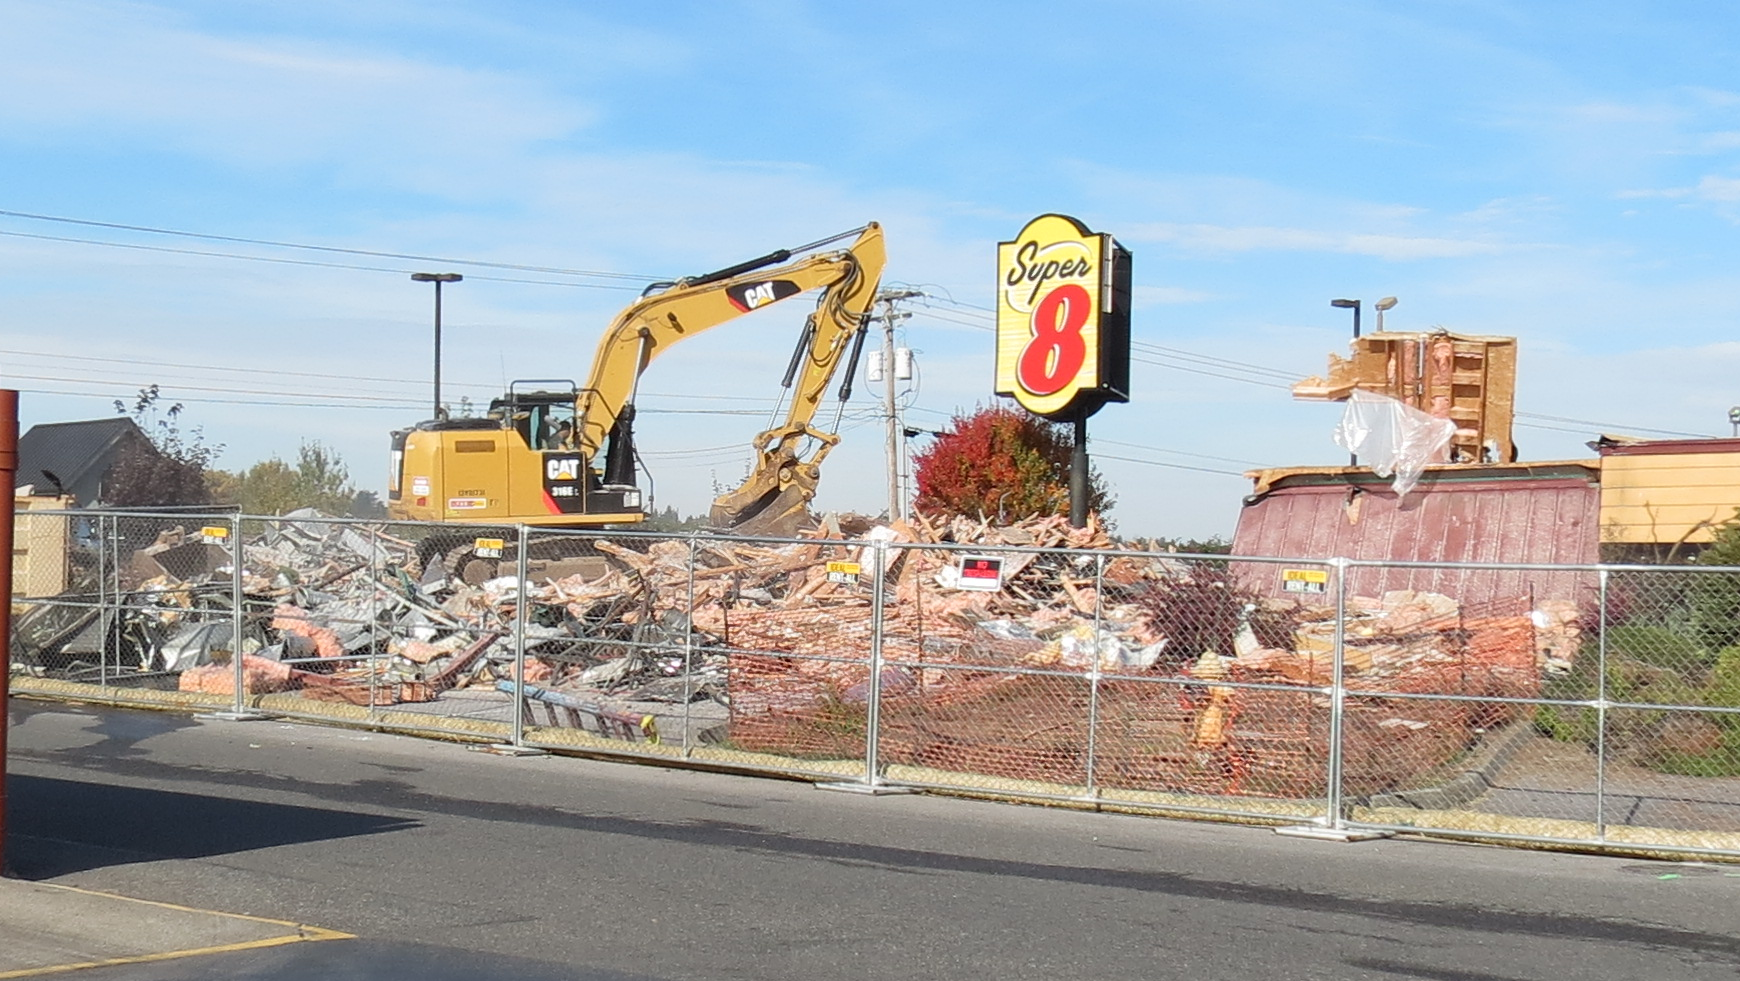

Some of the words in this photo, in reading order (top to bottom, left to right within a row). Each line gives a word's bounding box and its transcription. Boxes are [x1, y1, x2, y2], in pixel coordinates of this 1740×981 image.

[744, 281, 776, 309] CAT
[1007, 240, 1092, 305] Super
[1016, 283, 1092, 396] 8
[547, 459, 580, 480] CAT
